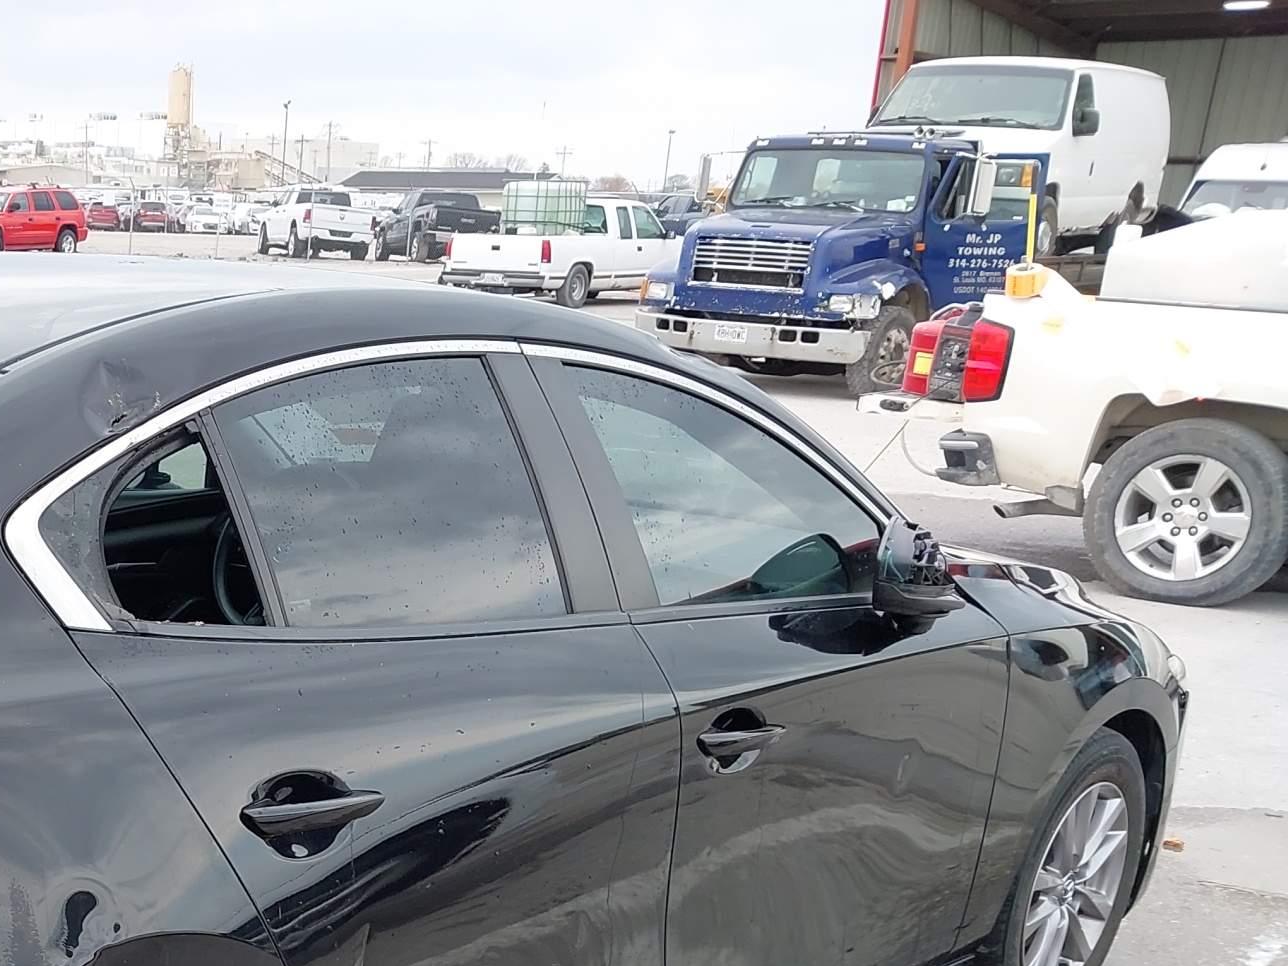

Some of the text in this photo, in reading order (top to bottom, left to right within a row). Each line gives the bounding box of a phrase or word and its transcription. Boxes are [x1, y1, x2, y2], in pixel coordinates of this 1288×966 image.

[966, 233, 1002, 244] Mr. JP
[957, 246, 1006, 256] TOWING
[953, 286, 975, 294] USDOT
